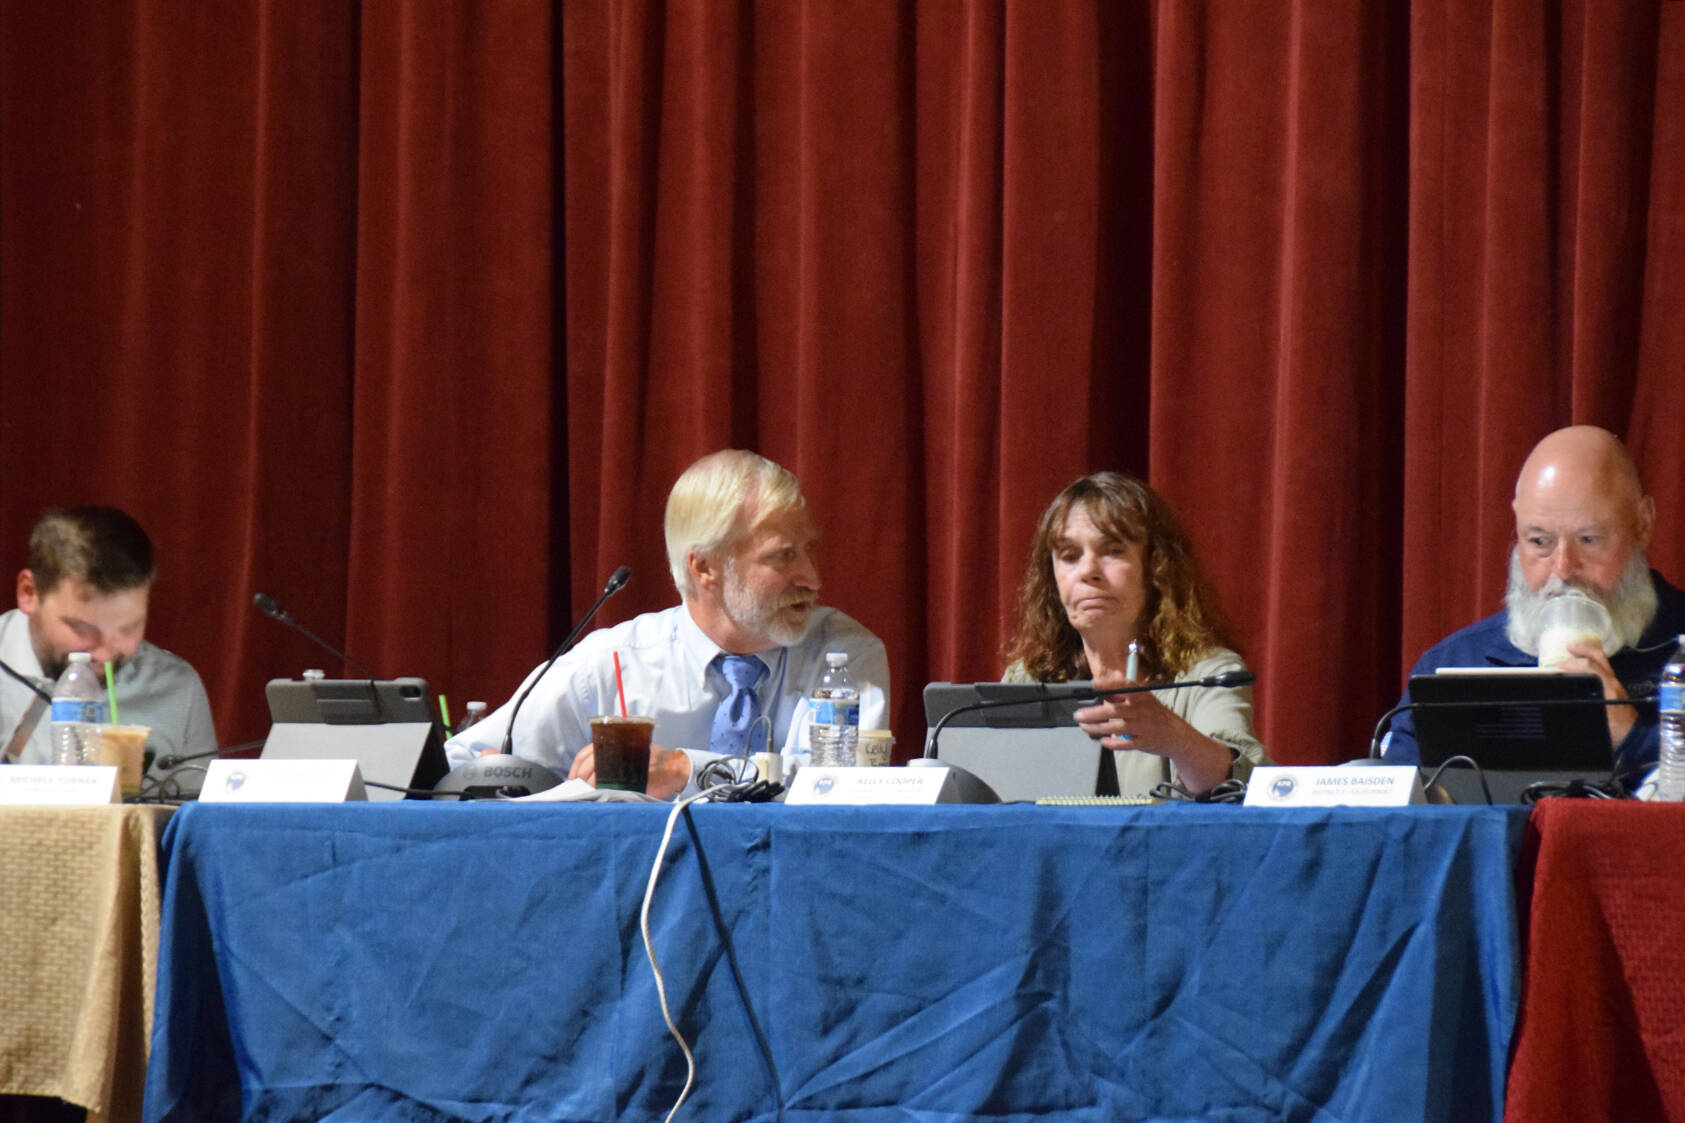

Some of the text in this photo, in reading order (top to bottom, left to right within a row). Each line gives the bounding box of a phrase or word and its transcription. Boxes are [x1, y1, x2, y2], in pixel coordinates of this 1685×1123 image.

[484, 766, 532, 778] BOSCH
[57, 776, 98, 785] TURNER
[857, 777, 924, 785] KELLY COOPER
[1314, 776, 1395, 786] JAMES BAISDEN
